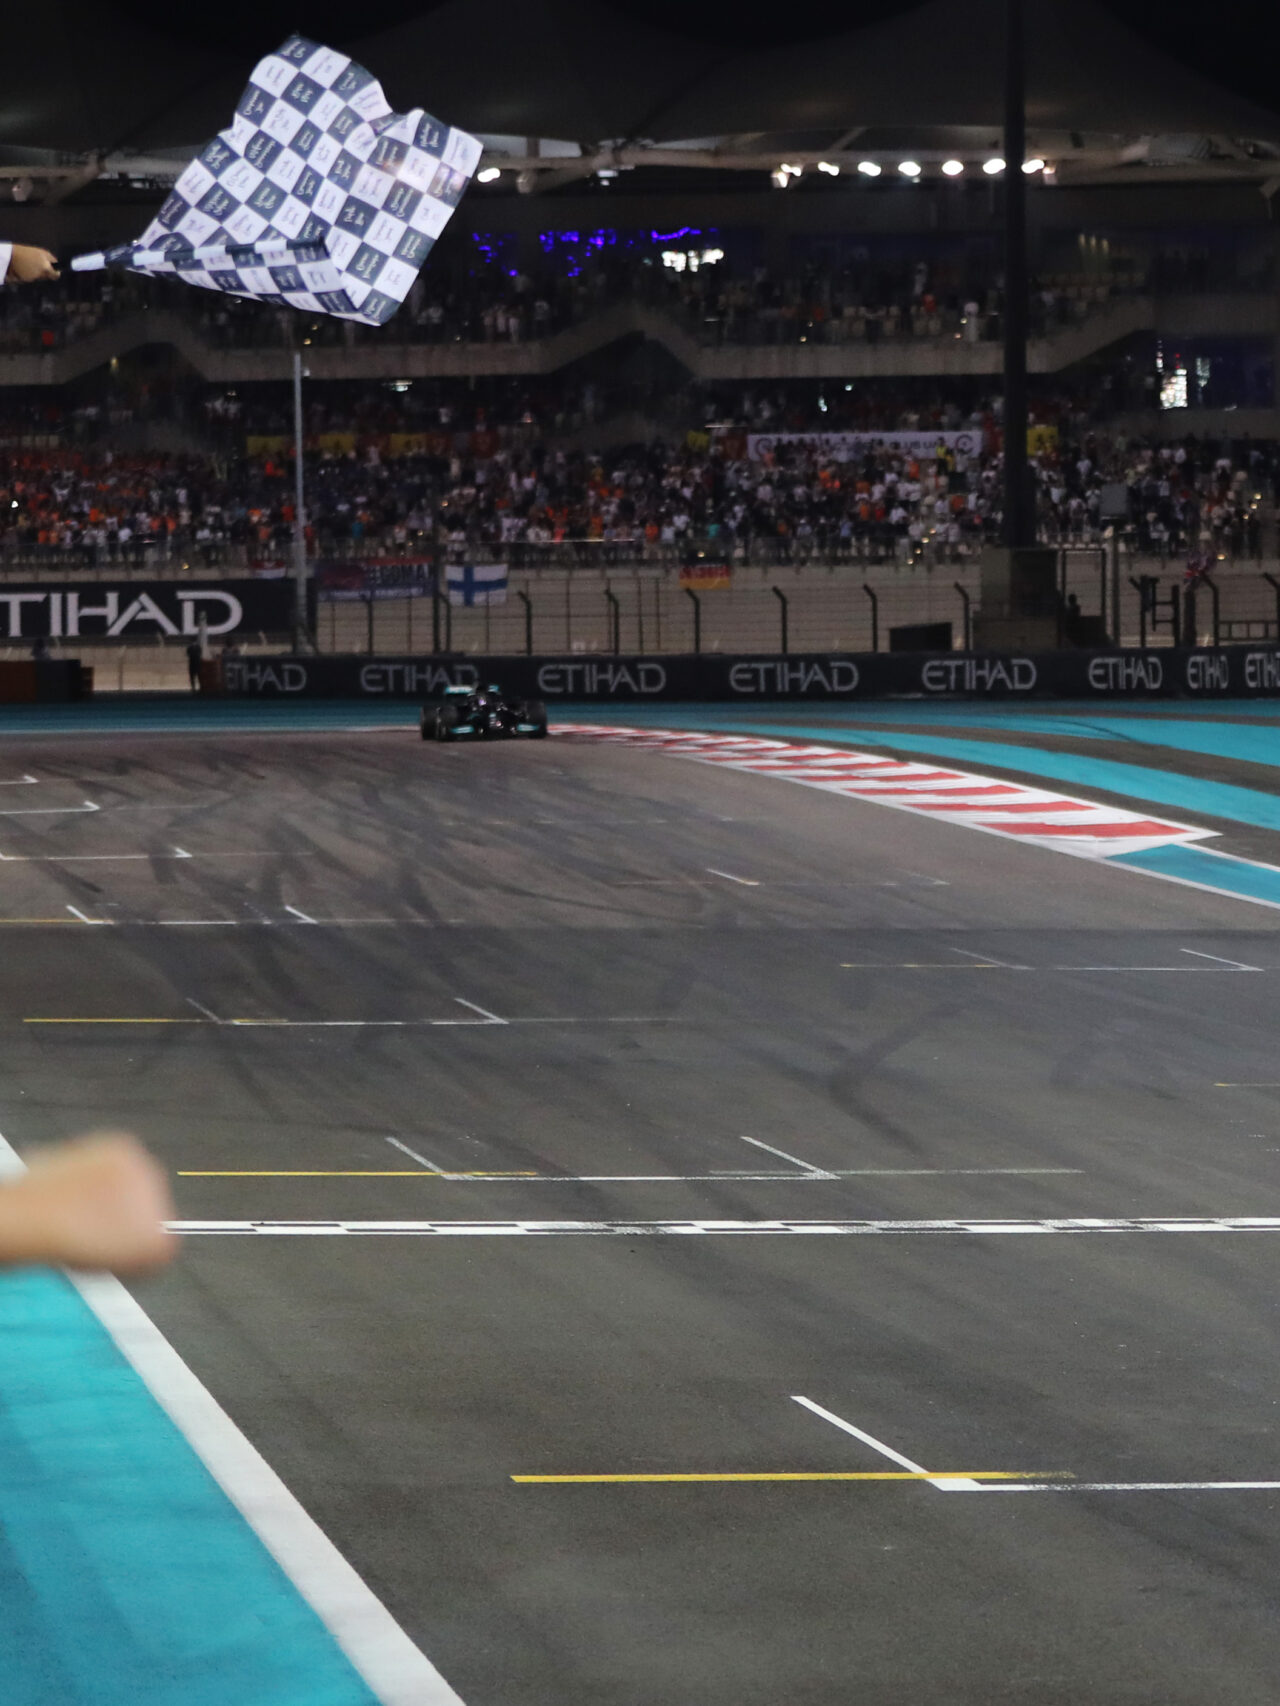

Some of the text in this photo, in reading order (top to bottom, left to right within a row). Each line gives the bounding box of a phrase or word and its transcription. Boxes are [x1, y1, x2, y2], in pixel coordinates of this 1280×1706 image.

[0, 590, 243, 636] TIHAD
[360, 664, 480, 693] ETIHAD
[537, 664, 667, 693] ETIHAD
[730, 661, 859, 692] ETIHAD
[921, 659, 1037, 690] ETIHAD
[1088, 657, 1163, 689] ETIHAD
